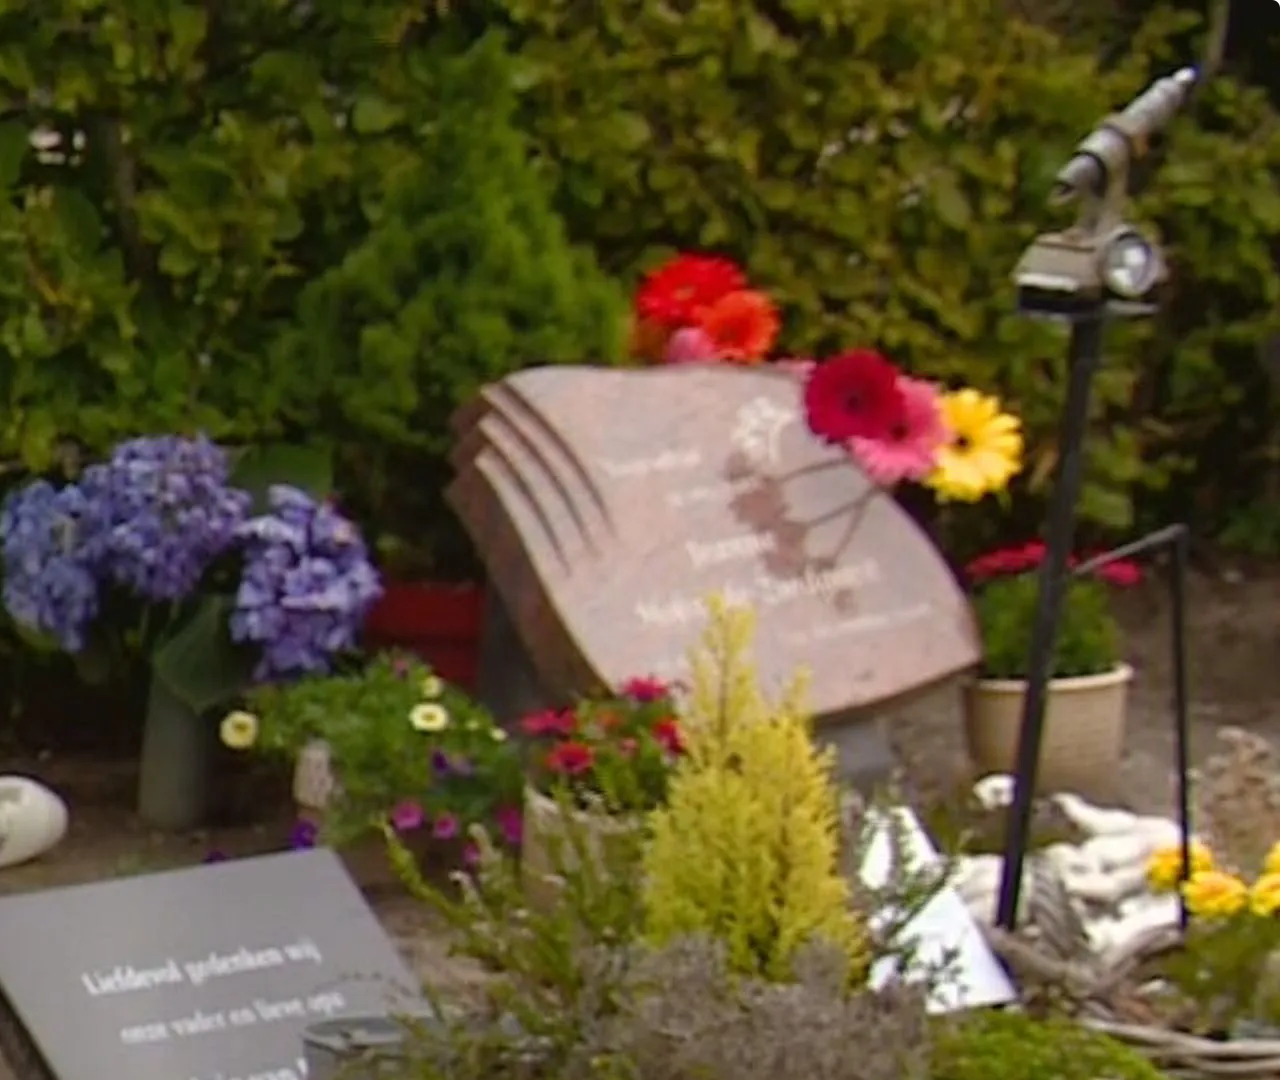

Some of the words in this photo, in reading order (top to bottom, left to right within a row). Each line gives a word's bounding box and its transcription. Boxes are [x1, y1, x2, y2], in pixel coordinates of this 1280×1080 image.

[80, 957, 184, 997] Liefdevol
[184, 946, 285, 988] gedenken
[283, 937, 322, 966] wij
[120, 1023, 169, 1045] onze
[168, 1010, 227, 1037] vader
[228, 1007, 257, 1027] en
[251, 998, 307, 1023] lieve
